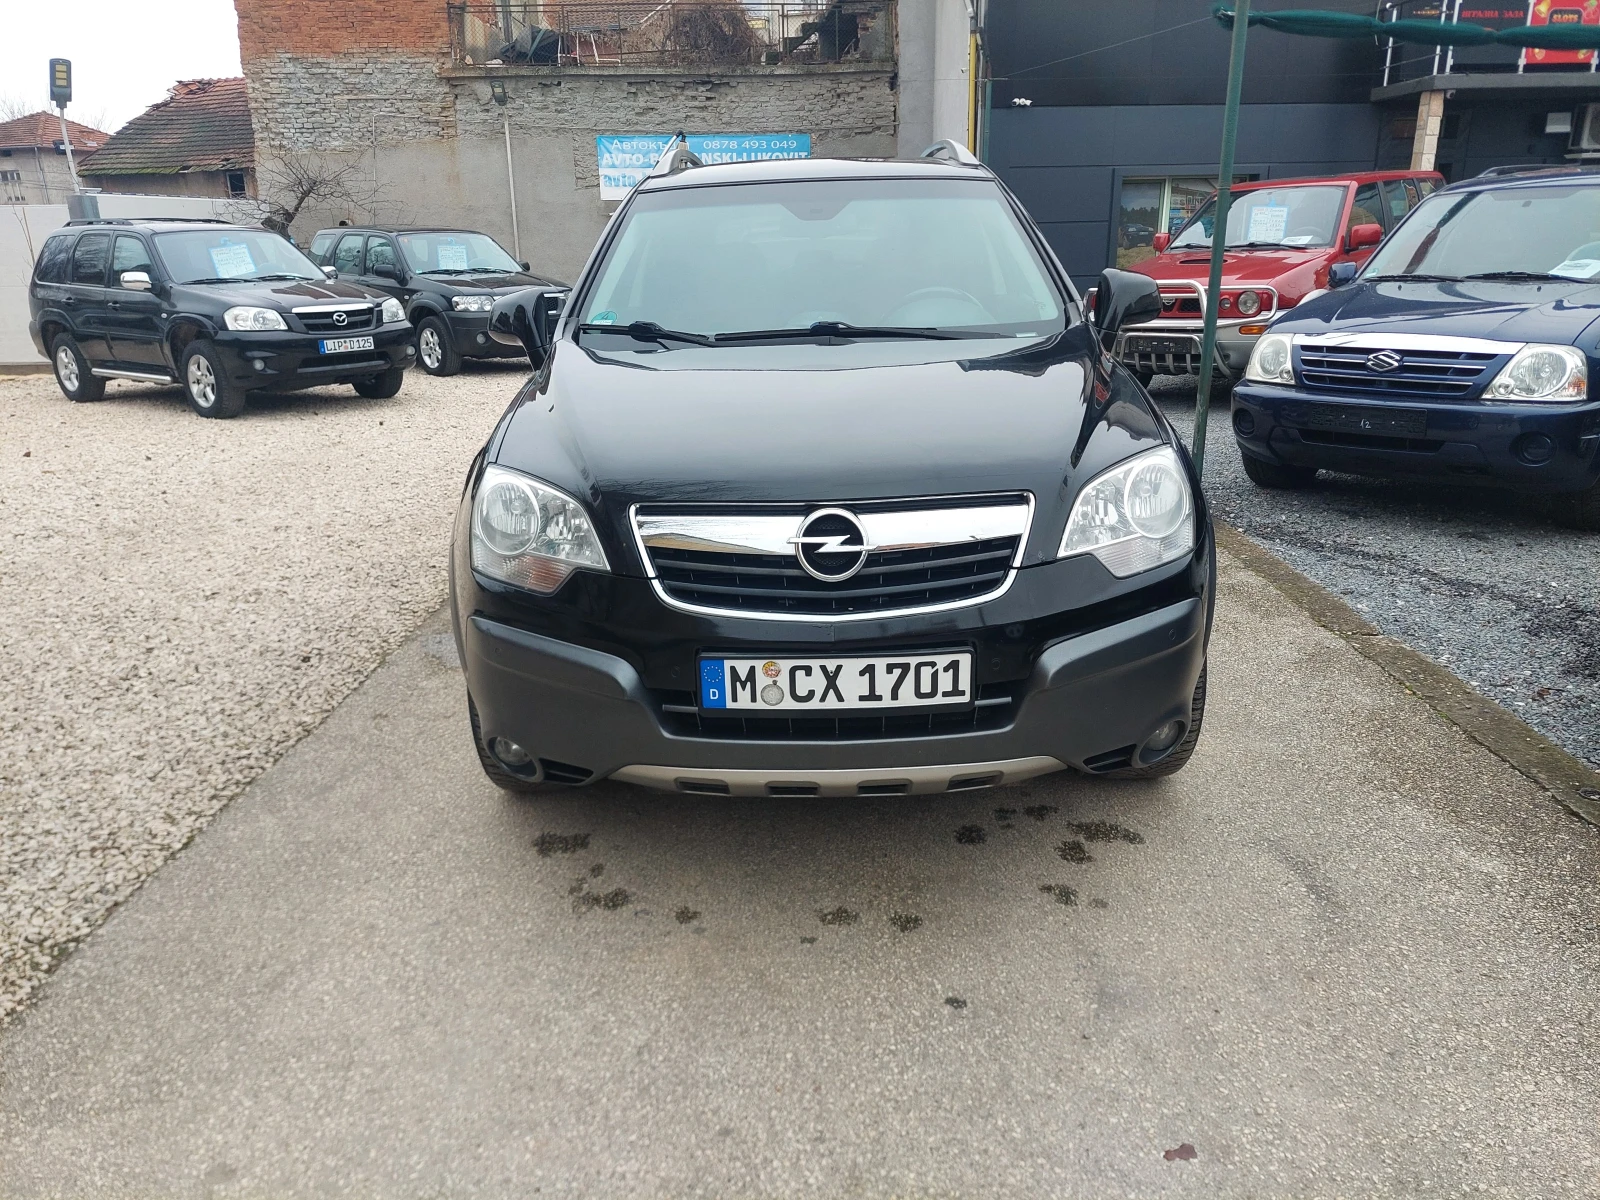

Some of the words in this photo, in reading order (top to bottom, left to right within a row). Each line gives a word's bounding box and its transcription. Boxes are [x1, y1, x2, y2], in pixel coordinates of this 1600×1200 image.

[1552, 14, 1578, 23] SLOTS
[703, 140, 738, 150] 0878
[741, 140, 767, 149] 493
[771, 139, 797, 149] 049
[325, 341, 343, 352] LIP
[1360, 419, 1371, 428] 12
[710, 689, 719, 700] D
[730, 666, 757, 703] M
[789, 664, 845, 703] CX
[858, 659, 966, 702] 1701
